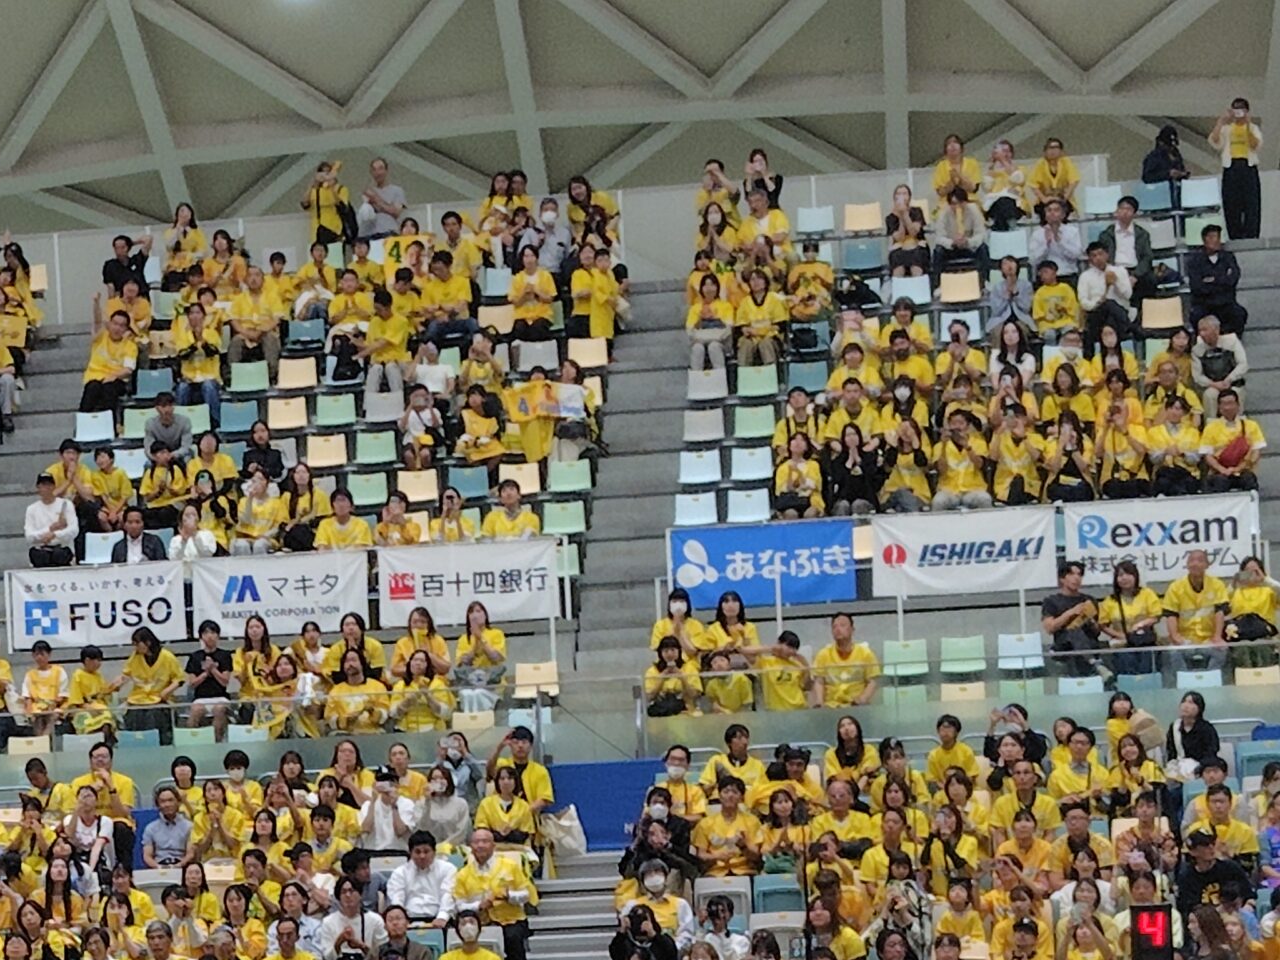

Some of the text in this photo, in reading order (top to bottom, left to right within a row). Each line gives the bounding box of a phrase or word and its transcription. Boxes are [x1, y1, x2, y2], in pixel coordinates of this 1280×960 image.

[1078, 515, 1239, 549] Rexxam
[725, 545, 851, 581] あなぶき
[918, 536, 1045, 567] ISHIGAKI
[268, 574, 339, 597] マキタ
[421, 567, 548, 597] 百十四銀行
[69, 597, 172, 631] FUSO
[1138, 911, 1167, 948] 4
